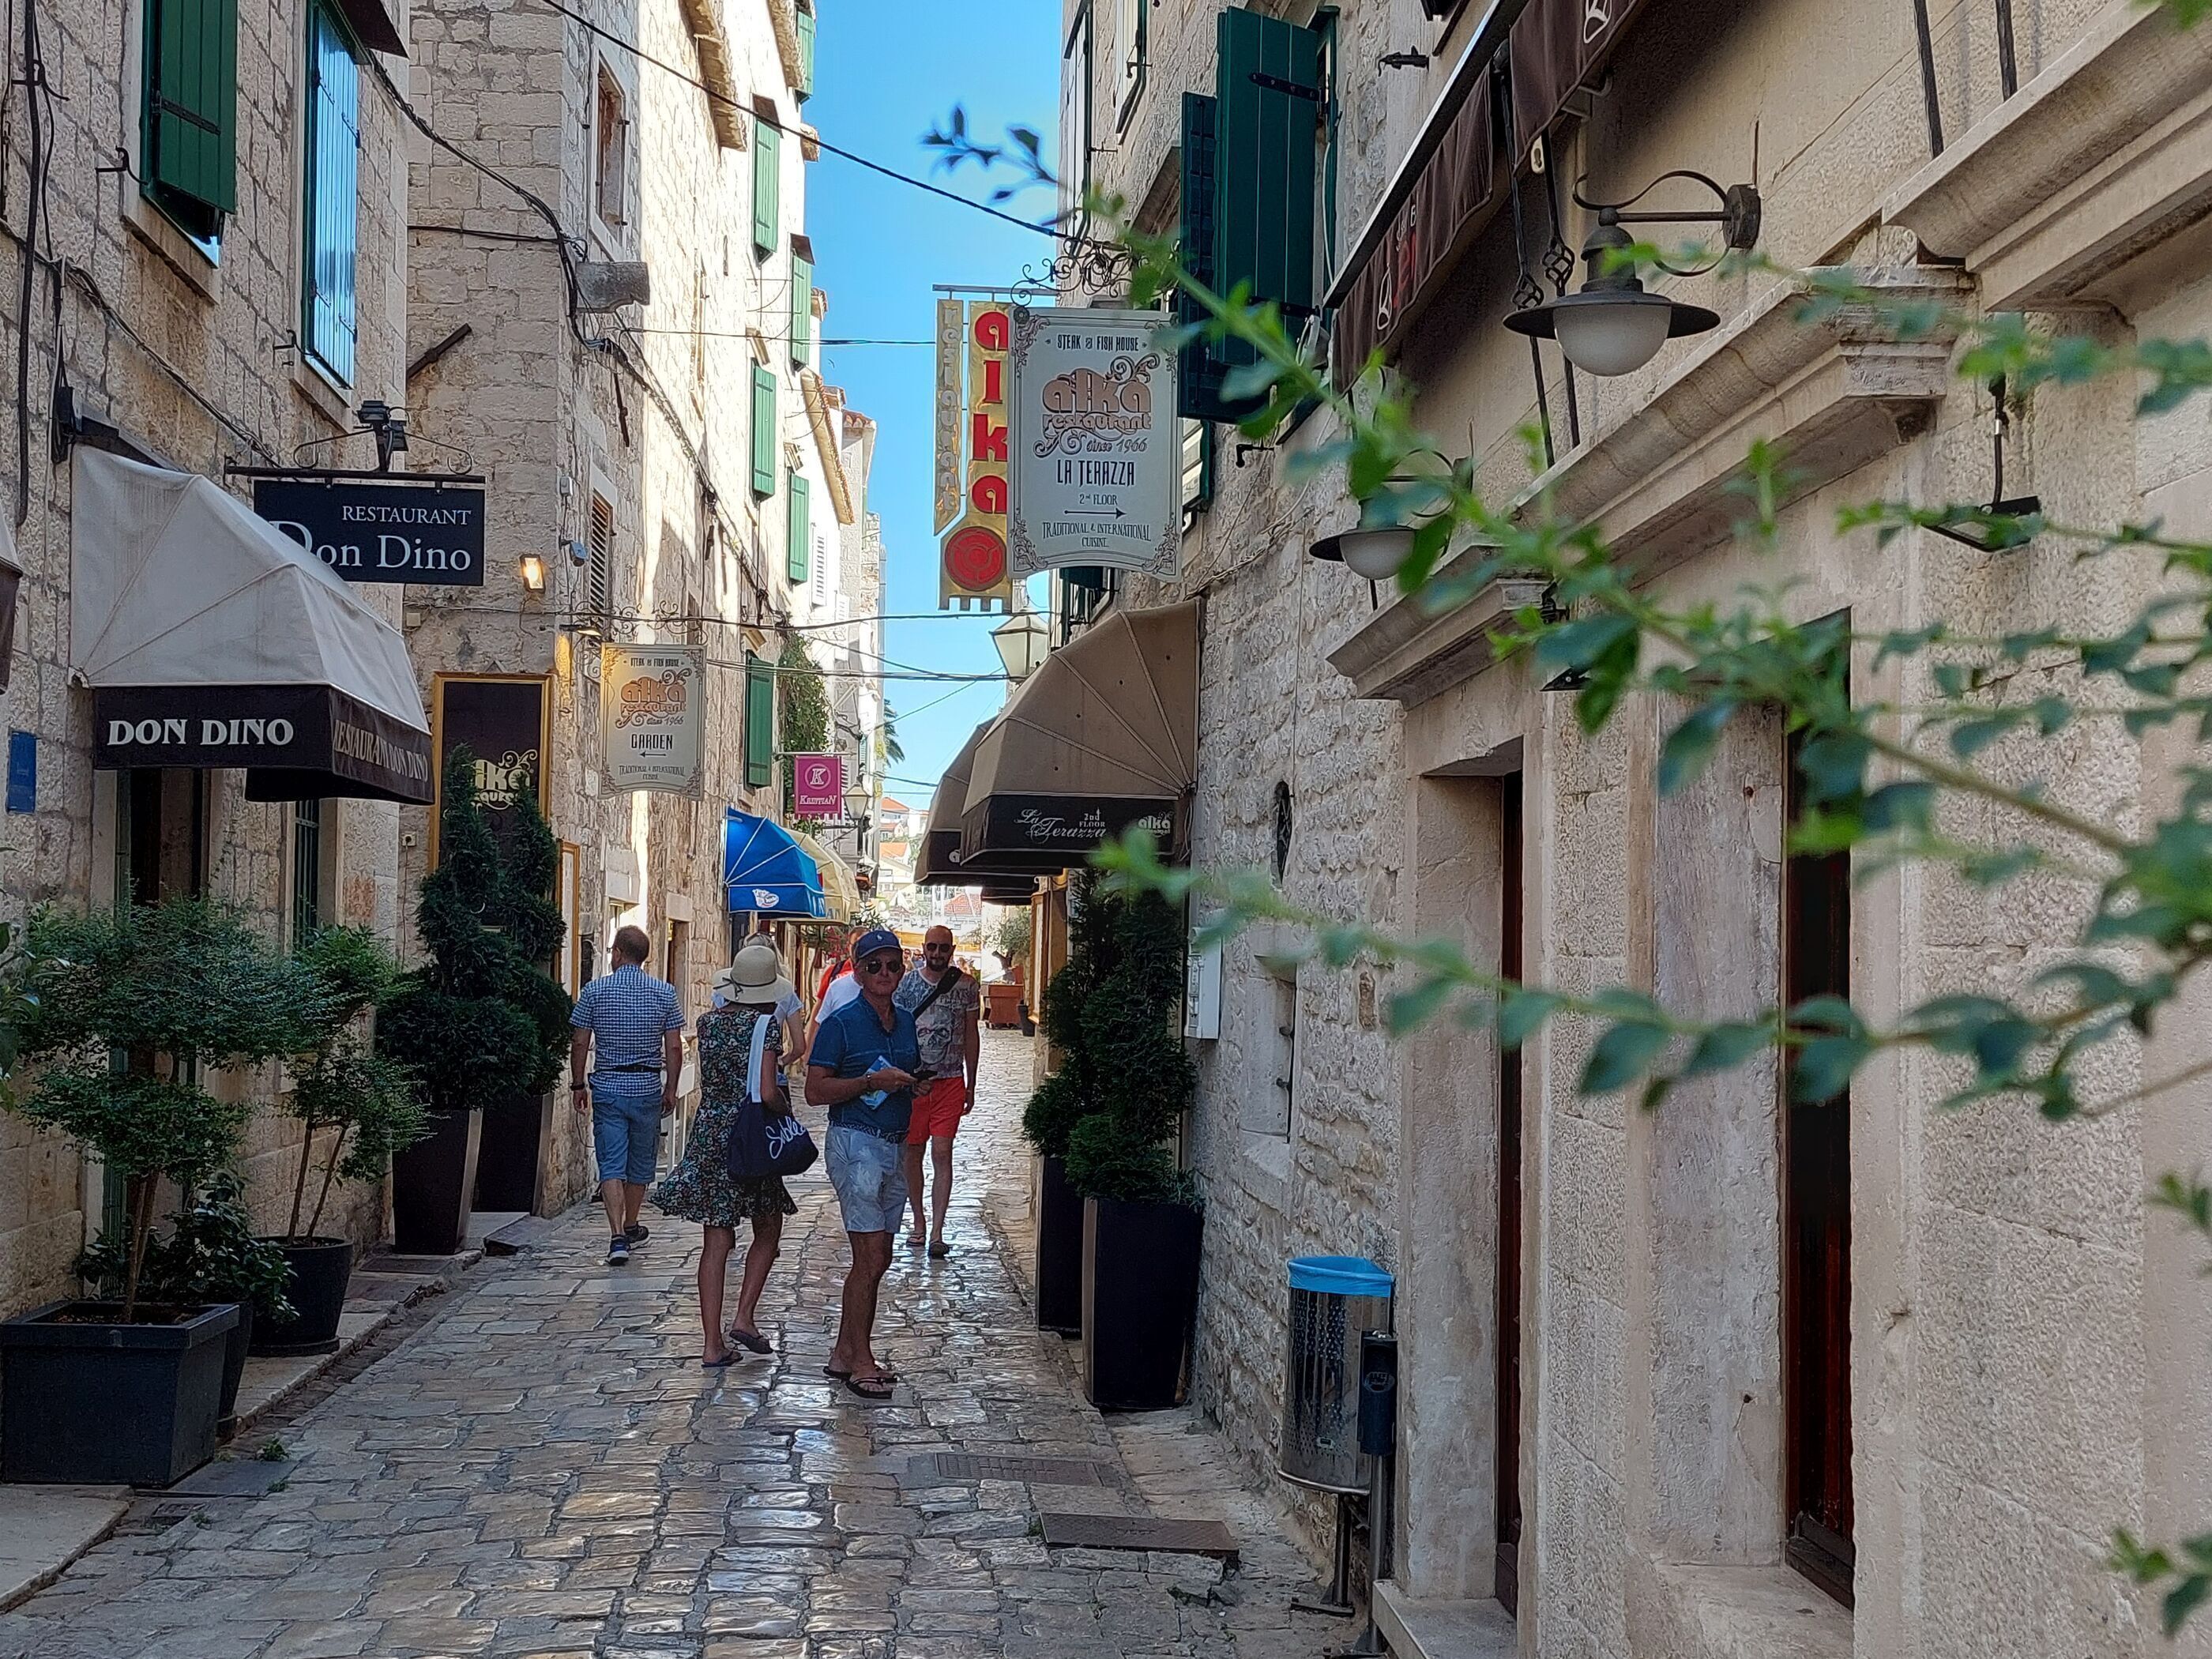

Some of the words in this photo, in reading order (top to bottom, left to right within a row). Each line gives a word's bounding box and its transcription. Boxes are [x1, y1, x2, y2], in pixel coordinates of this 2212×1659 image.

[1057, 334, 1082, 350] STEAK
[1097, 336, 1113, 351] FISH
[1115, 337, 1138, 352] HOUSE
[1043, 368, 1151, 413] alka
[972, 311, 1009, 514] alka
[1042, 412, 1152, 431] restaurant
[1115, 437, 1148, 454] 1966
[1057, 460, 1071, 485] LA
[1078, 461, 1134, 487] TERAZZA
[1093, 495, 1118, 506] FLOOR
[342, 506, 472, 525] RESTAURANT
[1042, 521, 1089, 539] TRADITIONAL
[1097, 524, 1151, 542] INTERNATIONAL
[376, 535, 472, 571] Dino
[621, 677, 686, 702] alka
[107, 719, 187, 746] DON
[200, 719, 294, 746] DINO
[631, 734, 673, 750] GARDEN
[810, 768, 826, 785] K
[1014, 809, 1041, 823] La
[1025, 818, 1106, 844] Terazza
